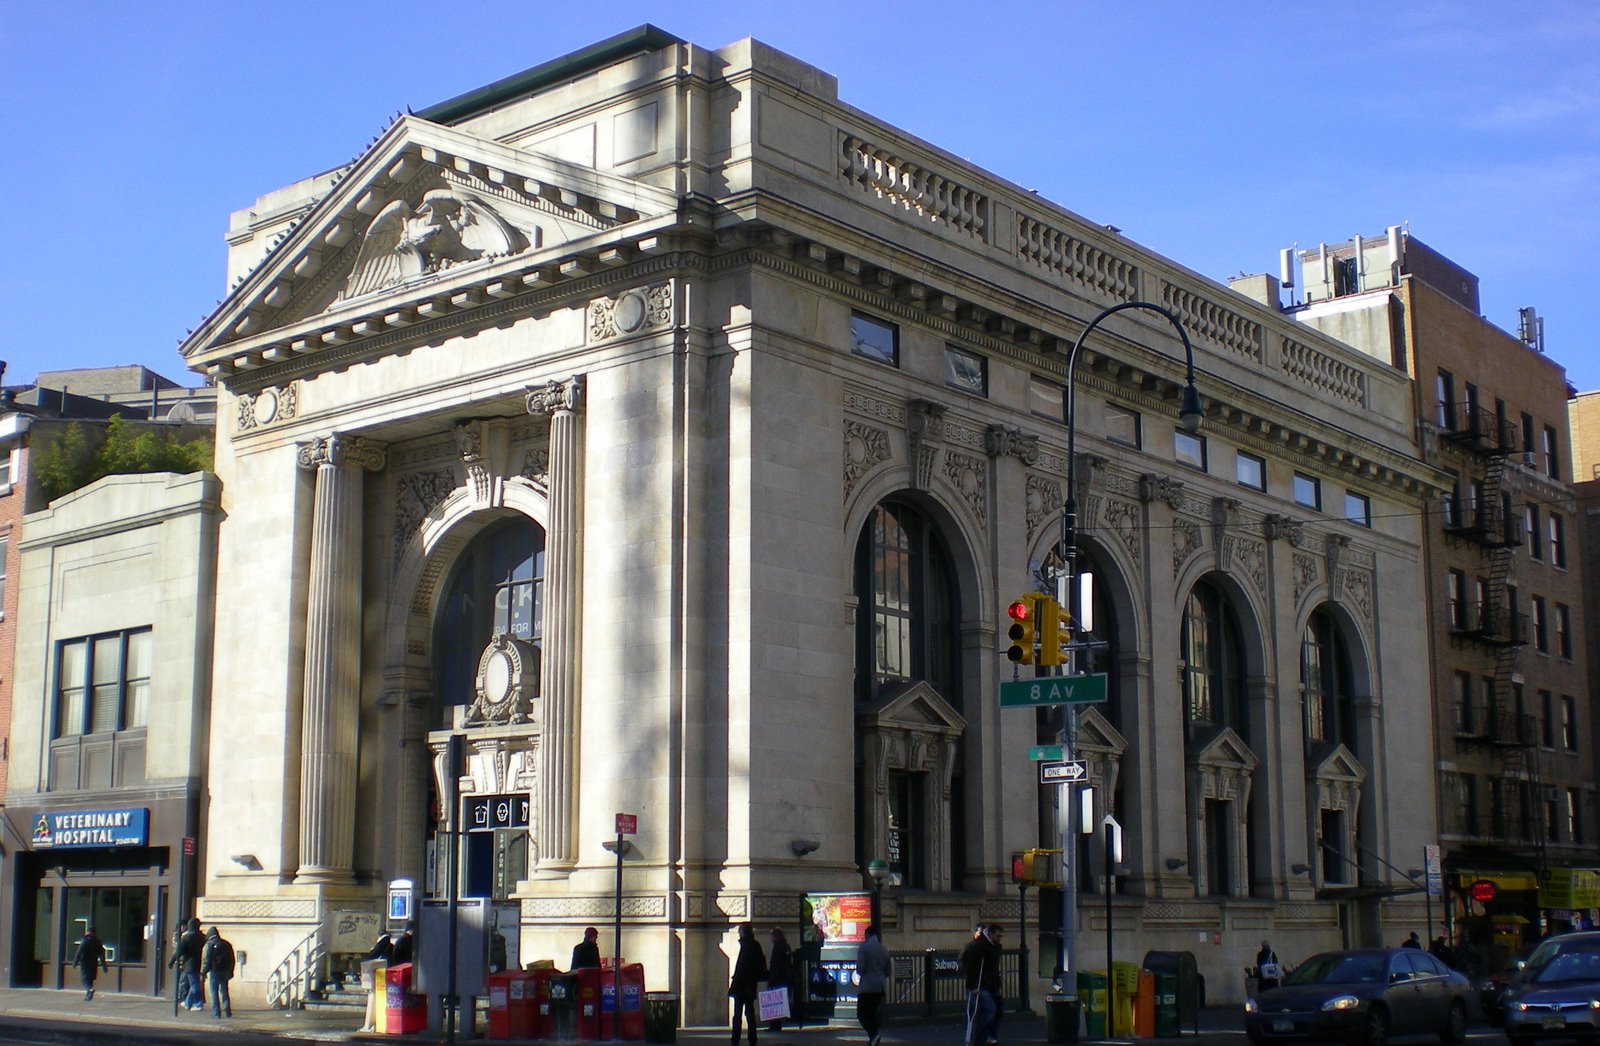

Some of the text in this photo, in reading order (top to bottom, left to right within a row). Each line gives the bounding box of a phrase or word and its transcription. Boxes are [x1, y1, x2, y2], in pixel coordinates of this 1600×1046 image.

[510, 622, 528, 634] FOR
[1030, 682, 1074, 700] 8 Av
[1047, 766, 1080, 777] ONE WAY
[55, 812, 131, 829] VETERINARY
[55, 829, 114, 845] HOSPITAL
[935, 959, 959, 972] Subway
[812, 972, 820, 983] A
[826, 971, 834, 983] C
[841, 972, 848, 983] E
